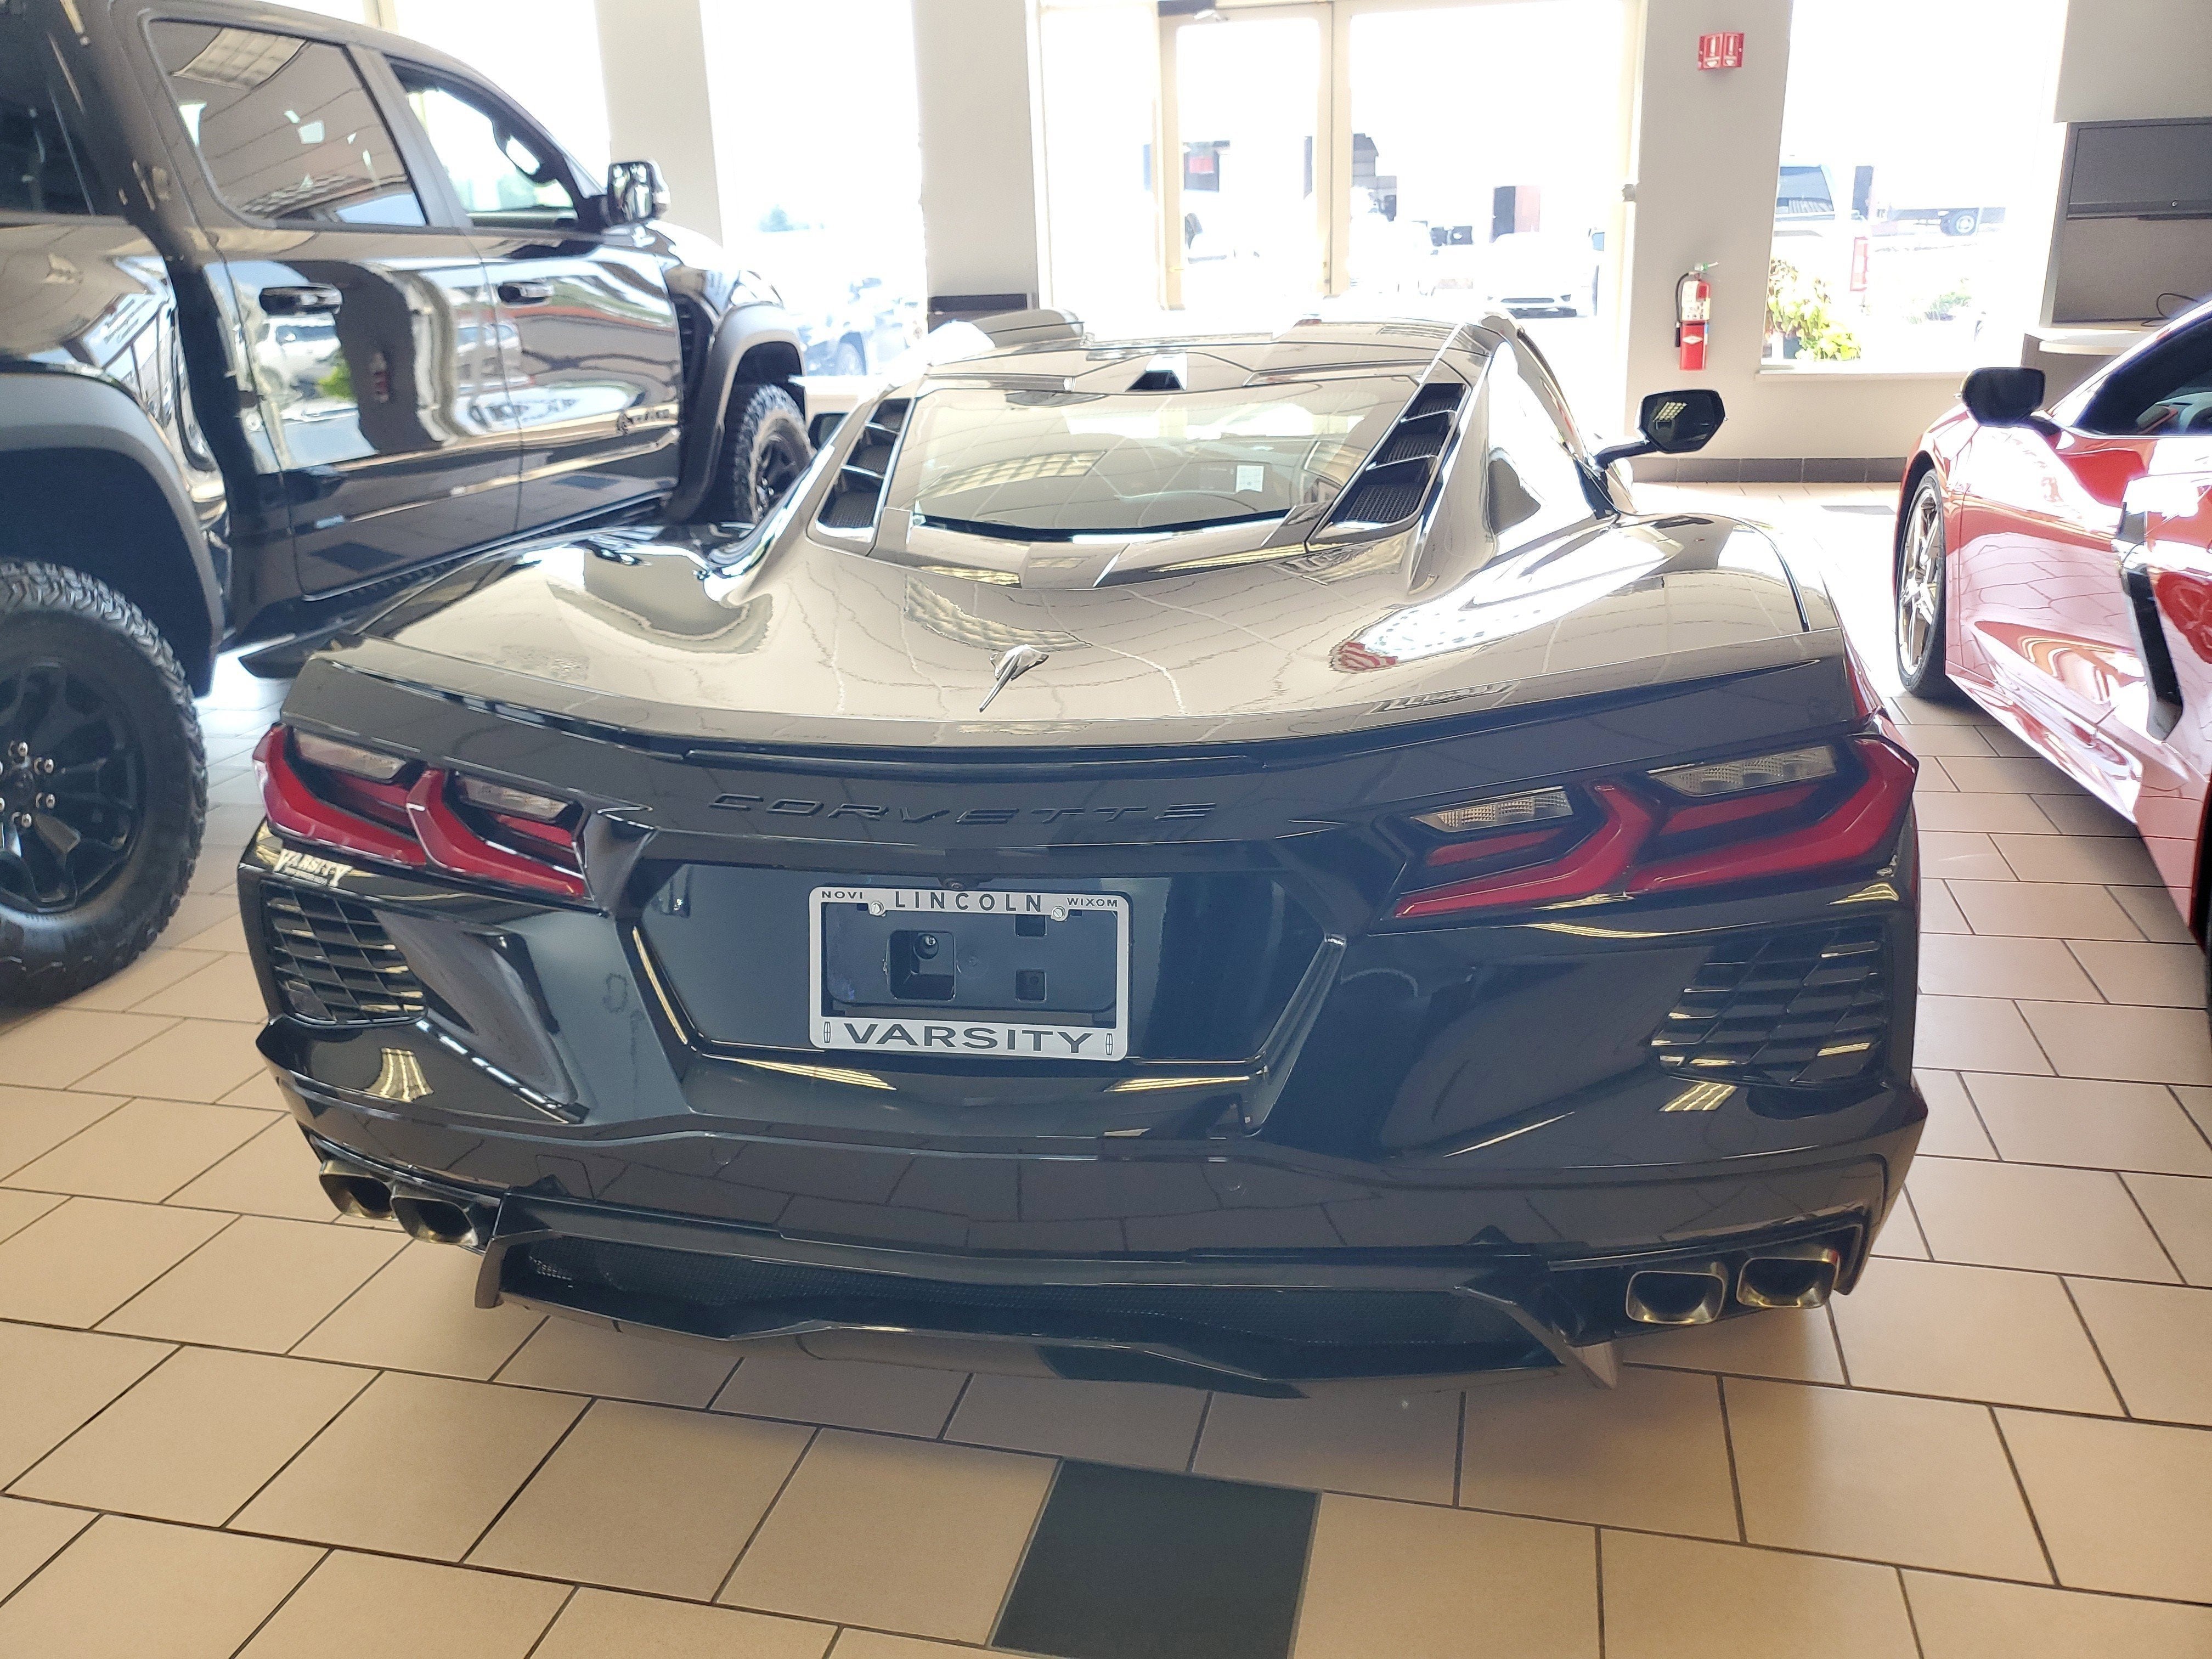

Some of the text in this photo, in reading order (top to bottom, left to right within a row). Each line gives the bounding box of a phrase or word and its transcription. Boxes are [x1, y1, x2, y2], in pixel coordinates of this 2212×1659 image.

[708, 793, 1216, 825] CORVETTE
[274, 849, 353, 888] VARSITY
[821, 890, 864, 900] NOVI
[895, 890, 1041, 912] LINCOLN
[1066, 897, 1118, 907] WIXOM
[843, 1023, 1093, 1053] VARSITY
